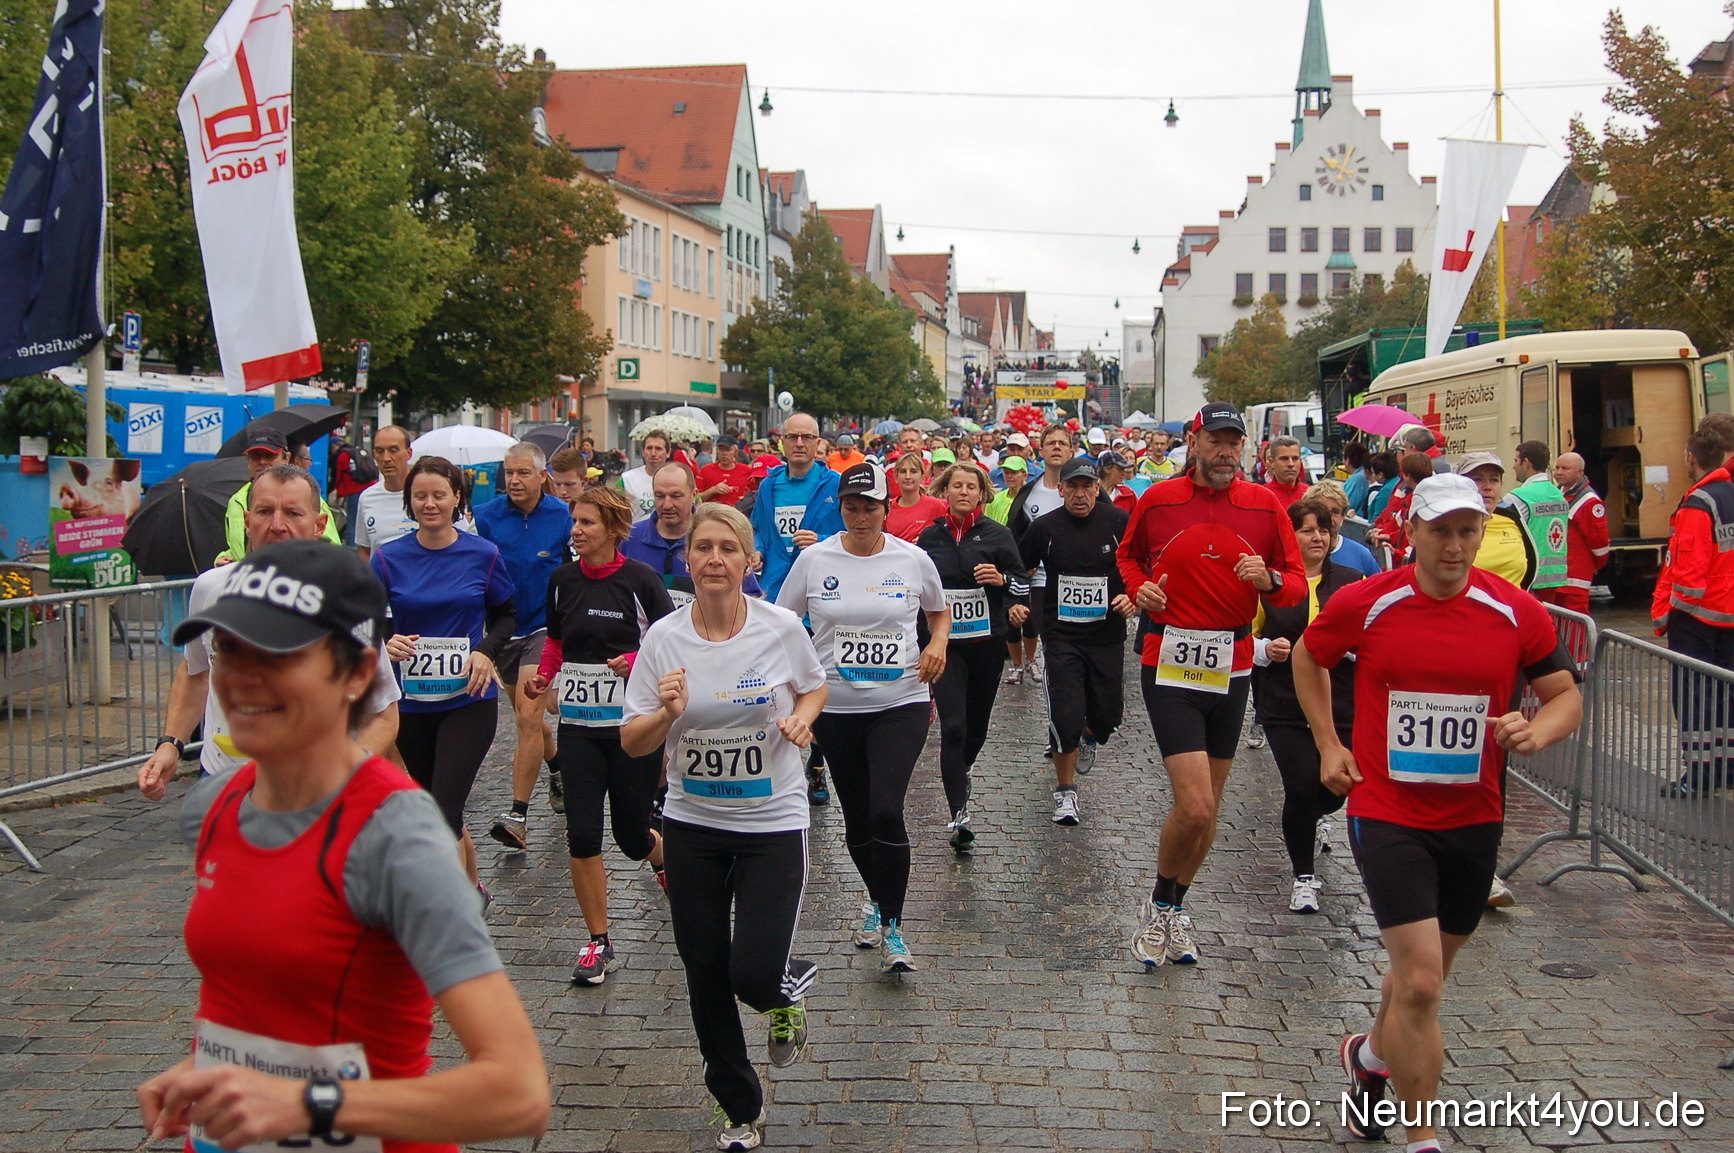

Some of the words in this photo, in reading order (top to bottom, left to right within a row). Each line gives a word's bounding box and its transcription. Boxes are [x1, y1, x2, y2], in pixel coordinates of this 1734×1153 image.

[127, 318, 138, 346] P
[620, 360, 636, 378] D
[1024, 388, 1056, 397] START
[1445, 384, 1495, 411] Bayerisches
[1445, 413, 1468, 431] Rotes
[1446, 436, 1467, 454] Kreuz
[639, 498, 656, 509] 20
[58, 531, 82, 542] BEIDE
[82, 526, 124, 539] STIMMEN
[779, 517, 798, 535] 28
[93, 559, 115, 571] UND
[94, 565, 131, 588] DU?
[222, 564, 324, 616] didas
[1062, 586, 1104, 606] 2554
[593, 609, 624, 620] PFLEIDERER
[952, 600, 985, 620] 030
[1069, 608, 1095, 616] Thomas
[836, 631, 859, 640] PARTL
[860, 632, 893, 640] Neumarkt
[423, 643, 458, 651] Neumarkt
[840, 641, 899, 665] 2882
[1174, 641, 1219, 669] 315
[406, 653, 463, 677] 2210
[562, 667, 579, 677] PARTL
[579, 670, 611, 678] Neumarkt
[848, 669, 890, 680] Christine
[1183, 670, 1203, 681] Rolf
[418, 683, 452, 692] Martina
[563, 679, 617, 704] 2517
[578, 709, 602, 719] Silvia
[1390, 699, 1423, 711] PARTL
[1425, 702, 1473, 713] Neumarkt
[680, 734, 707, 746] PARTL
[708, 734, 753, 746] Neumarkt
[1397, 713, 1478, 750] 3109
[686, 745, 764, 778] 2970
[709, 784, 743, 796] Silvia
[198, 1035, 242, 1066] PARTL
[244, 1052, 330, 1080] Neumarkt
